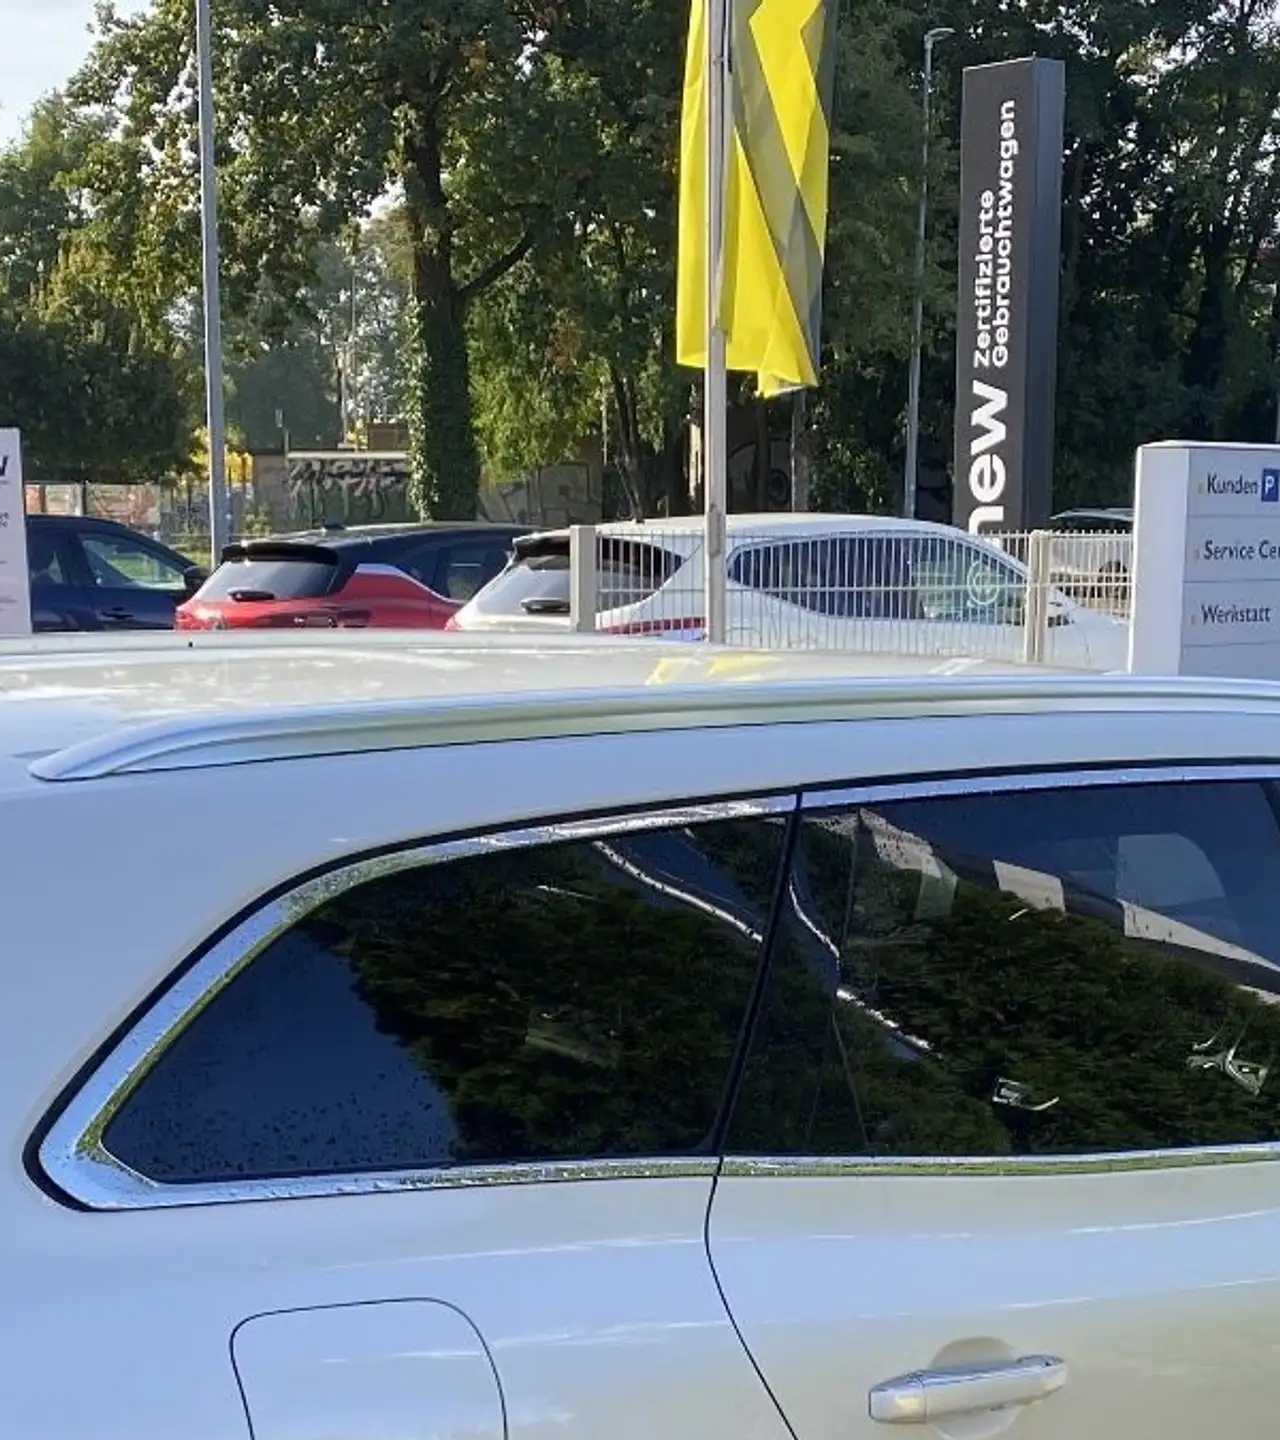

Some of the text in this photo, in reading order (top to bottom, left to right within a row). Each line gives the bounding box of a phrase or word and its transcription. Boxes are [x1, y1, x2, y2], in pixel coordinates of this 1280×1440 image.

[991, 99, 1019, 368] Gebrauchtwagen
[973, 189, 995, 368] Zertifizierte
[1206, 474, 1259, 495] Kunden
[1203, 539, 1255, 560] Service
[1201, 604, 1271, 624] Werkstatt
